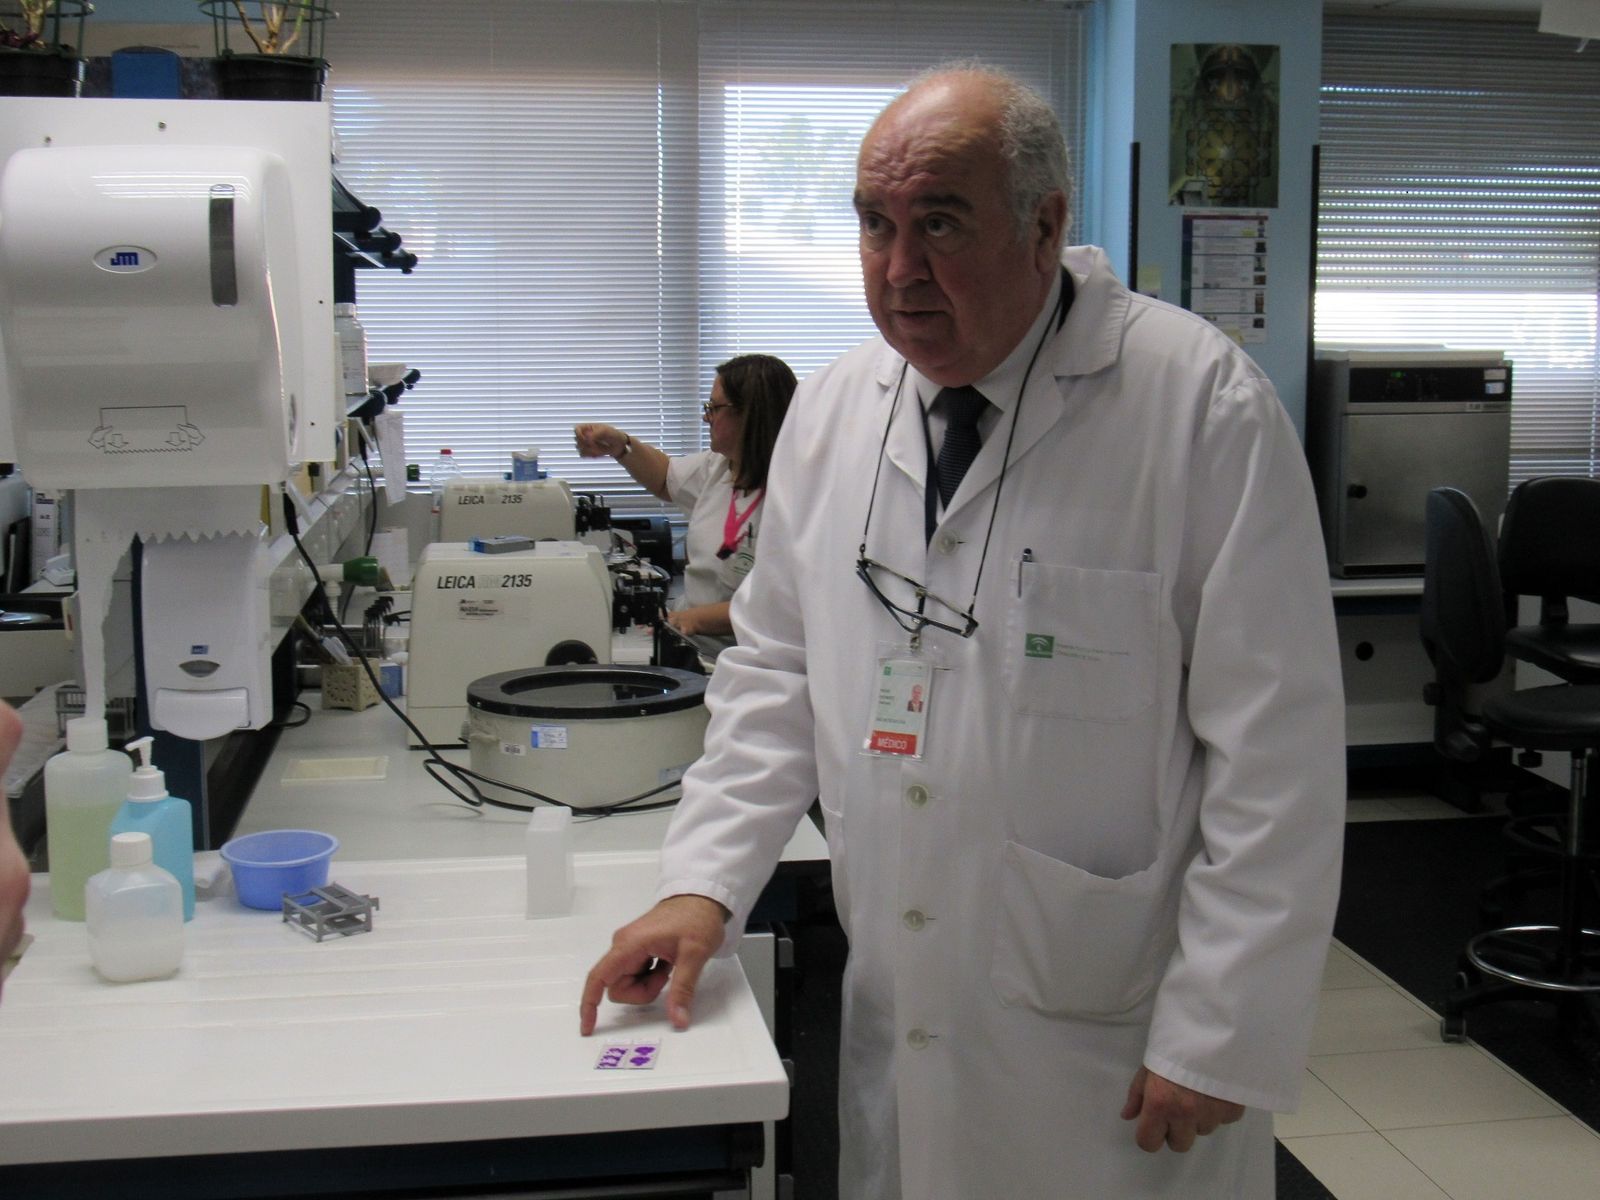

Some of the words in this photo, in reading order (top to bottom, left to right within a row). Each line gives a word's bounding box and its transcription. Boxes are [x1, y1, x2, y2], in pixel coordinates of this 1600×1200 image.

[458, 495, 485, 505] LEICA
[501, 494, 522, 504] 2135
[437, 575, 476, 589] LEICA
[501, 574, 532, 588] 2135
[877, 736, 908, 750] MÉDICO
